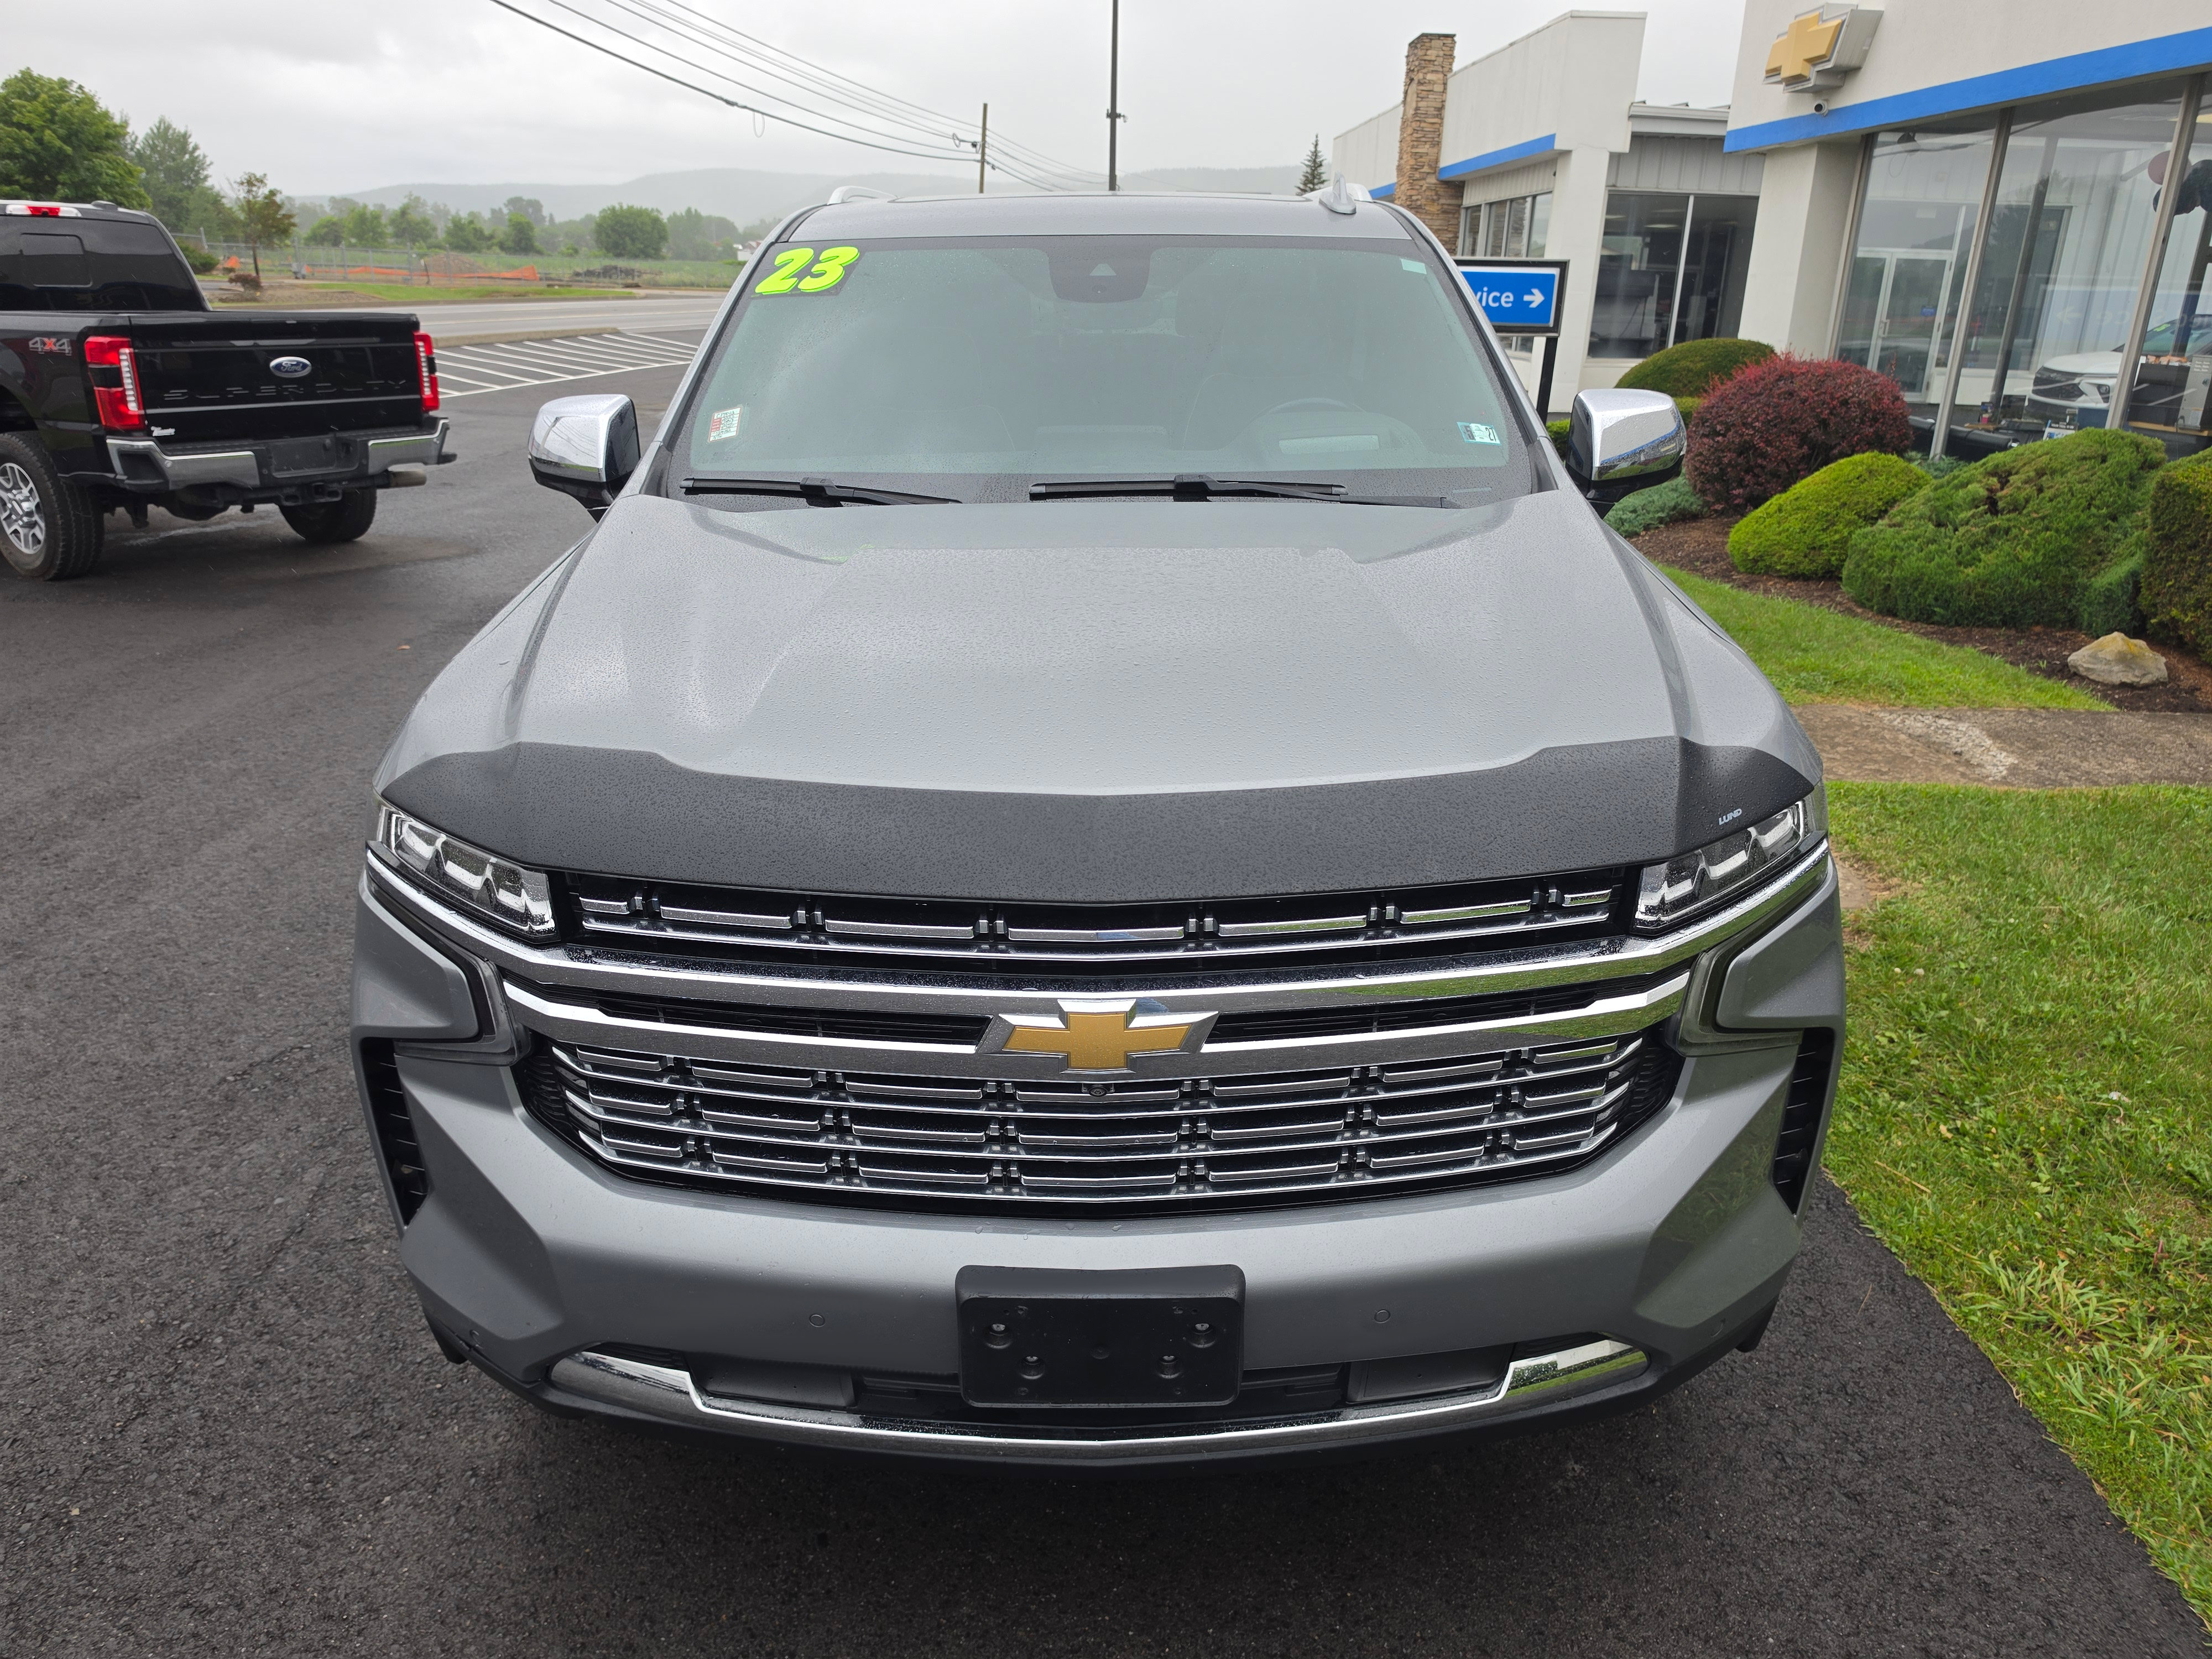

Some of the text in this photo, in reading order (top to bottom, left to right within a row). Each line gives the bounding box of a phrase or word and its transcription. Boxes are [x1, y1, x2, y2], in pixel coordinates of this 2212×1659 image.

[755, 247, 860, 295] 23
[281, 361, 302, 372] Ford
[1485, 427, 1496, 442] 27
[1718, 808, 1742, 825] LUND
